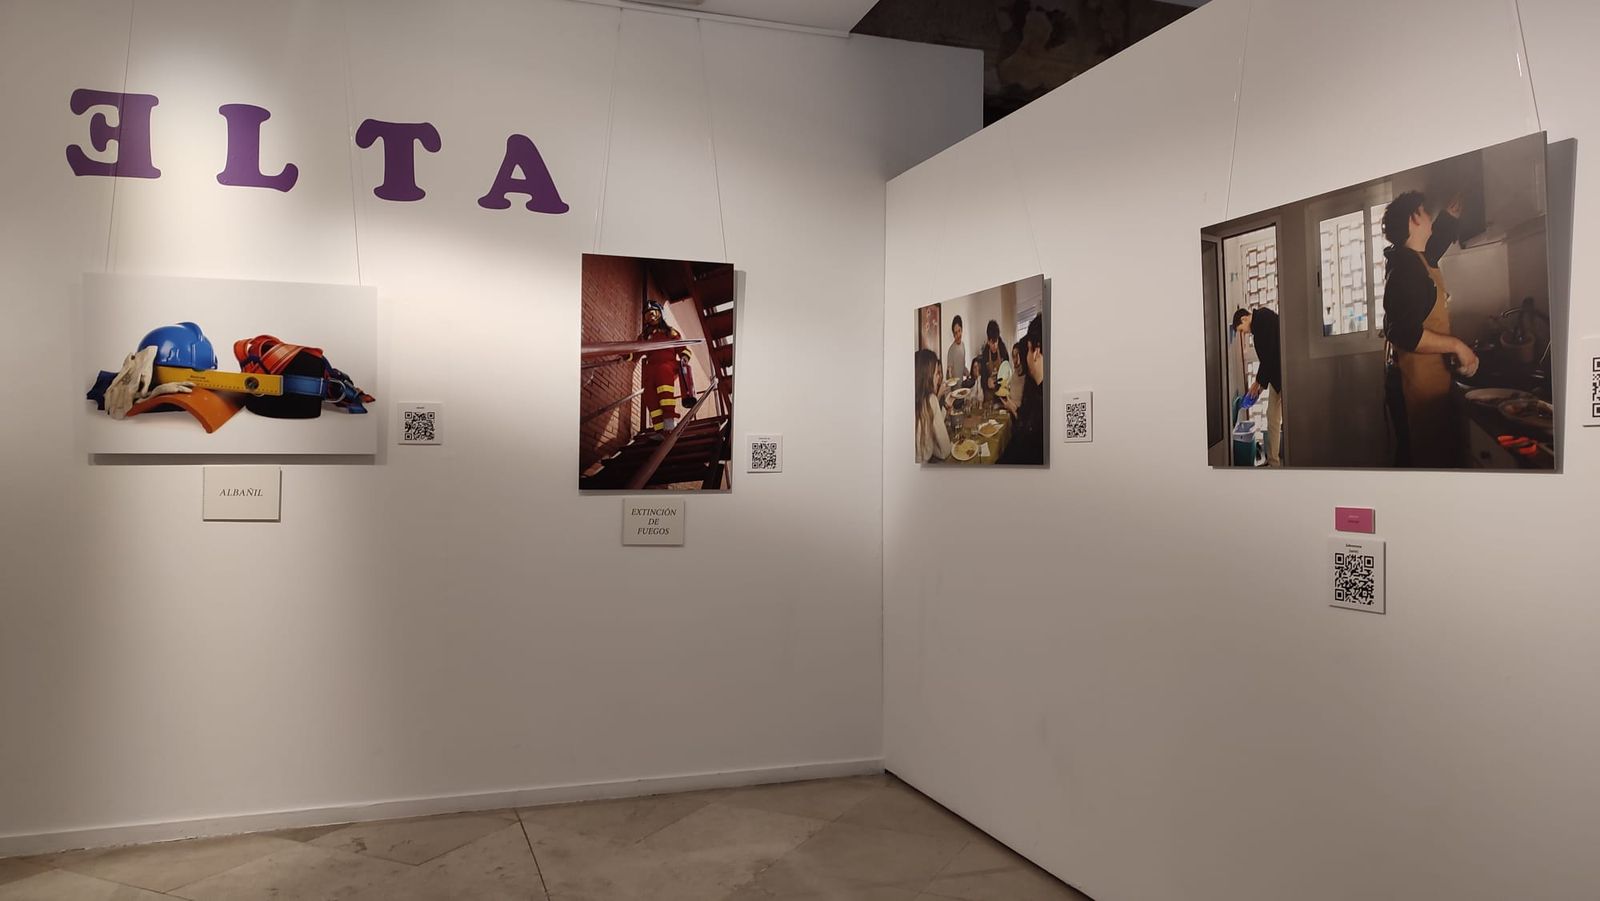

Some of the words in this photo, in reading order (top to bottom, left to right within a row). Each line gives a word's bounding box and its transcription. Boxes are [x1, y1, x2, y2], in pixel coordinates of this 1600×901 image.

[219, 487, 263, 497] ALBAÑIL
[631, 508, 676, 516] EXTINCIÓN
[648, 518, 660, 526] DE
[637, 527, 670, 536] FUEGOS
